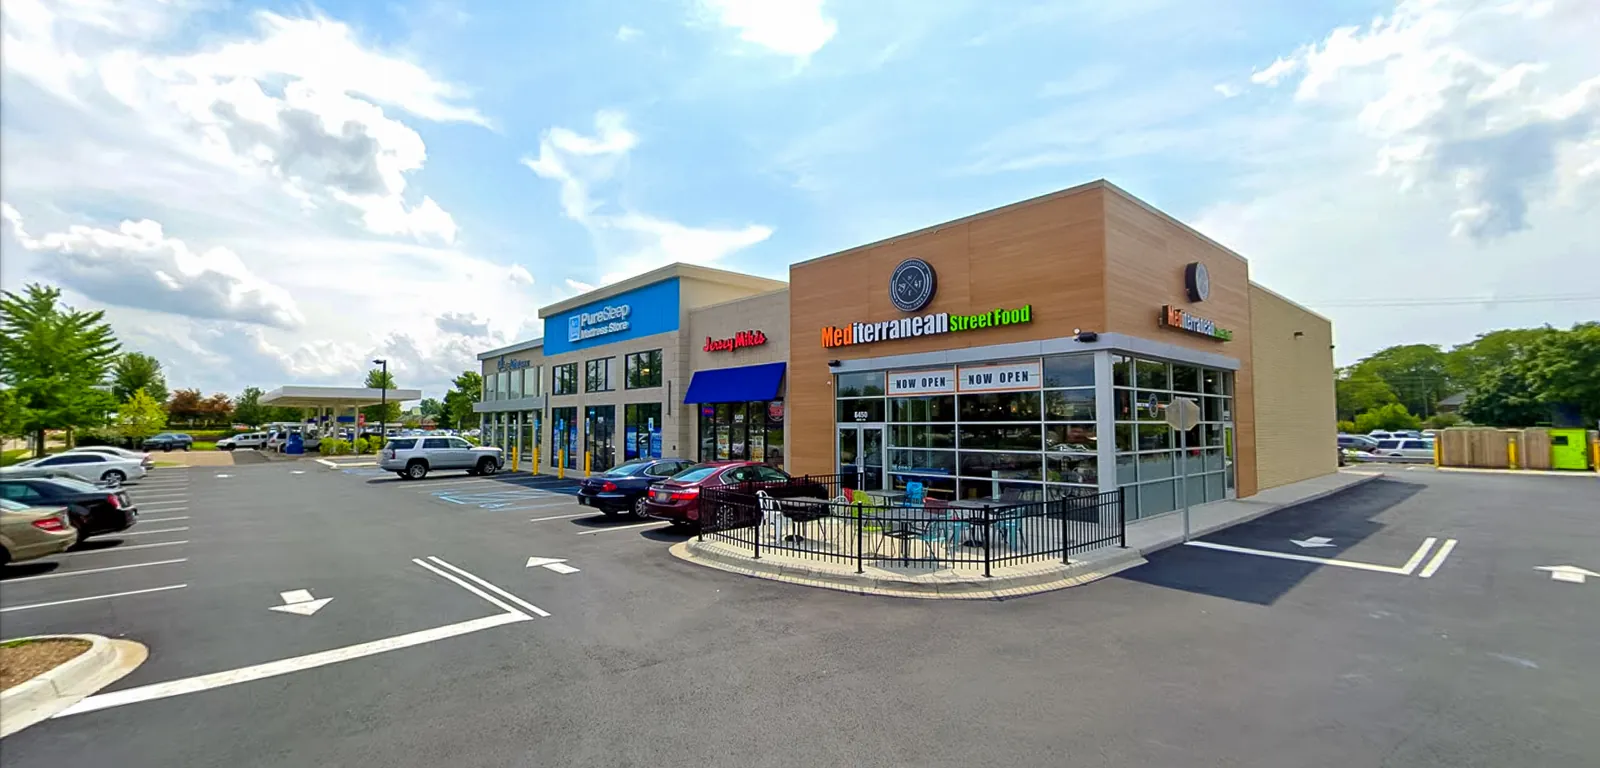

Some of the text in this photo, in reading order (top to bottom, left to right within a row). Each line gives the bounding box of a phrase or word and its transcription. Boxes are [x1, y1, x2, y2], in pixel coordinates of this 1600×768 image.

[821, 303, 1031, 348] Mediterranean Street Food
[703, 329, 767, 352] Jersey Mike's
[896, 376, 946, 389] NOW OPEN
[968, 370, 1029, 385] NOW OPEN
